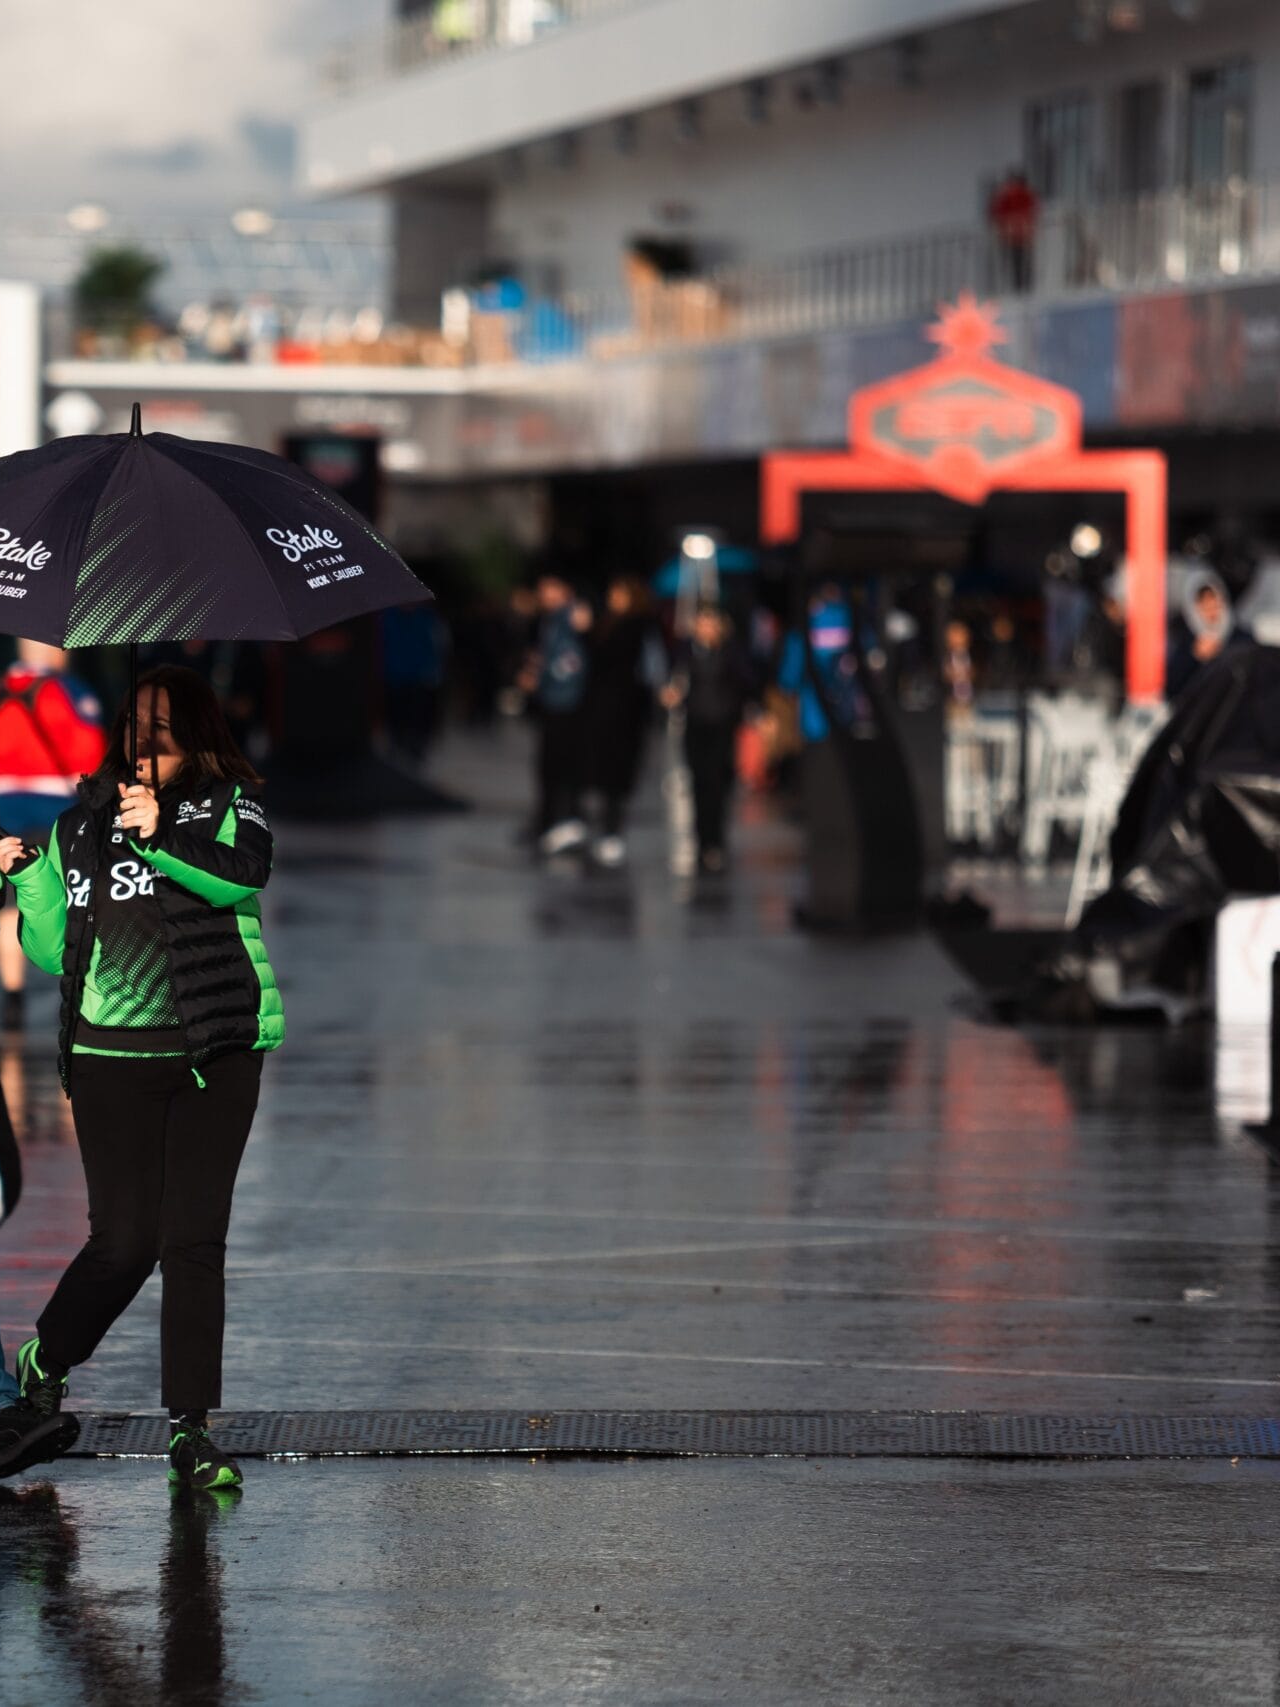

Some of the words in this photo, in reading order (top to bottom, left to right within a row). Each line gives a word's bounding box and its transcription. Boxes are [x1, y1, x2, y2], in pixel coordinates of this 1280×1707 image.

[266, 524, 342, 562] Stake
[316, 554, 346, 568] TEAM
[306, 574, 331, 590] KICK
[332, 565, 365, 581] SAUBER
